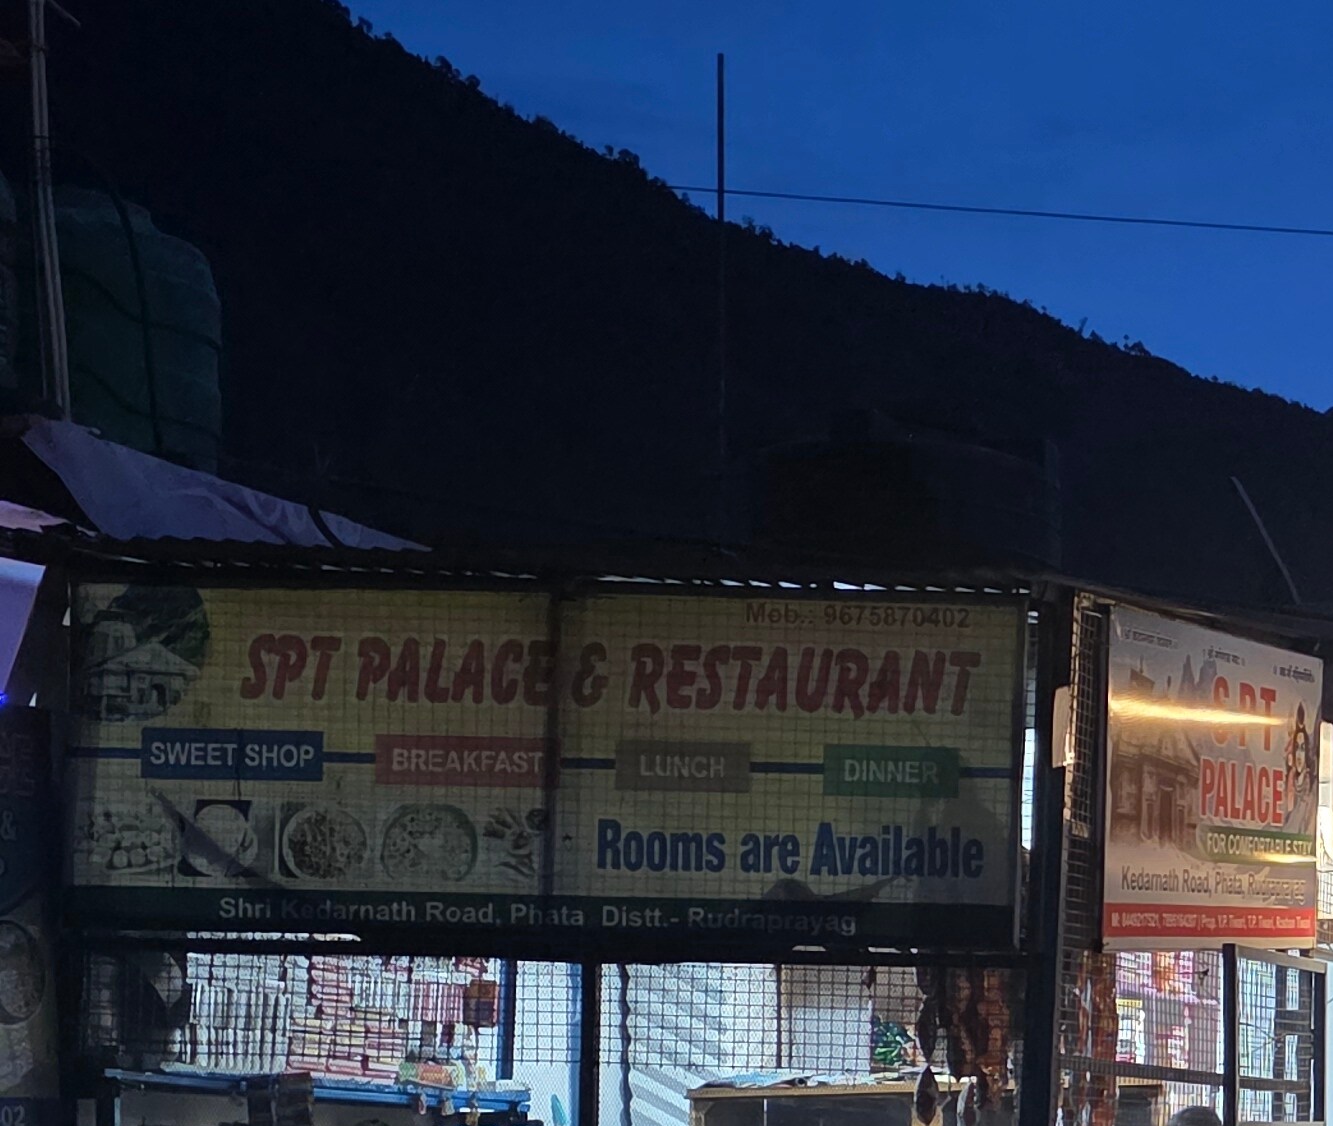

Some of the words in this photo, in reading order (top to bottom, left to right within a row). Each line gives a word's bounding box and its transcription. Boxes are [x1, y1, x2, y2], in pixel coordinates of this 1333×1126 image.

[824, 605, 971, 629] 9675870402
[241, 633, 342, 702] SPT
[355, 634, 555, 707] PALACE
[571, 642, 609, 708] &
[629, 643, 981, 719] RESTAURANT
[149, 741, 236, 767] SWEET
[244, 742, 316, 769] SHOP
[392, 747, 544, 775] BREAKFAST
[640, 754, 725, 778] LUNCH
[844, 758, 940, 785] DINNER
[1199, 758, 1285, 827] PALACE
[598, 818, 726, 873] Rooms
[740, 834, 801, 874] are
[810, 822, 986, 880] Available
[1122, 865, 1179, 893] Kedarnath
[1182, 869, 1212, 898] Road,
[219, 898, 272, 919] Shri
[281, 898, 416, 922] Kedarnath
[425, 900, 502, 927] Road,
[510, 903, 585, 927] Phata
[689, 908, 857, 936] Rudraprayag
